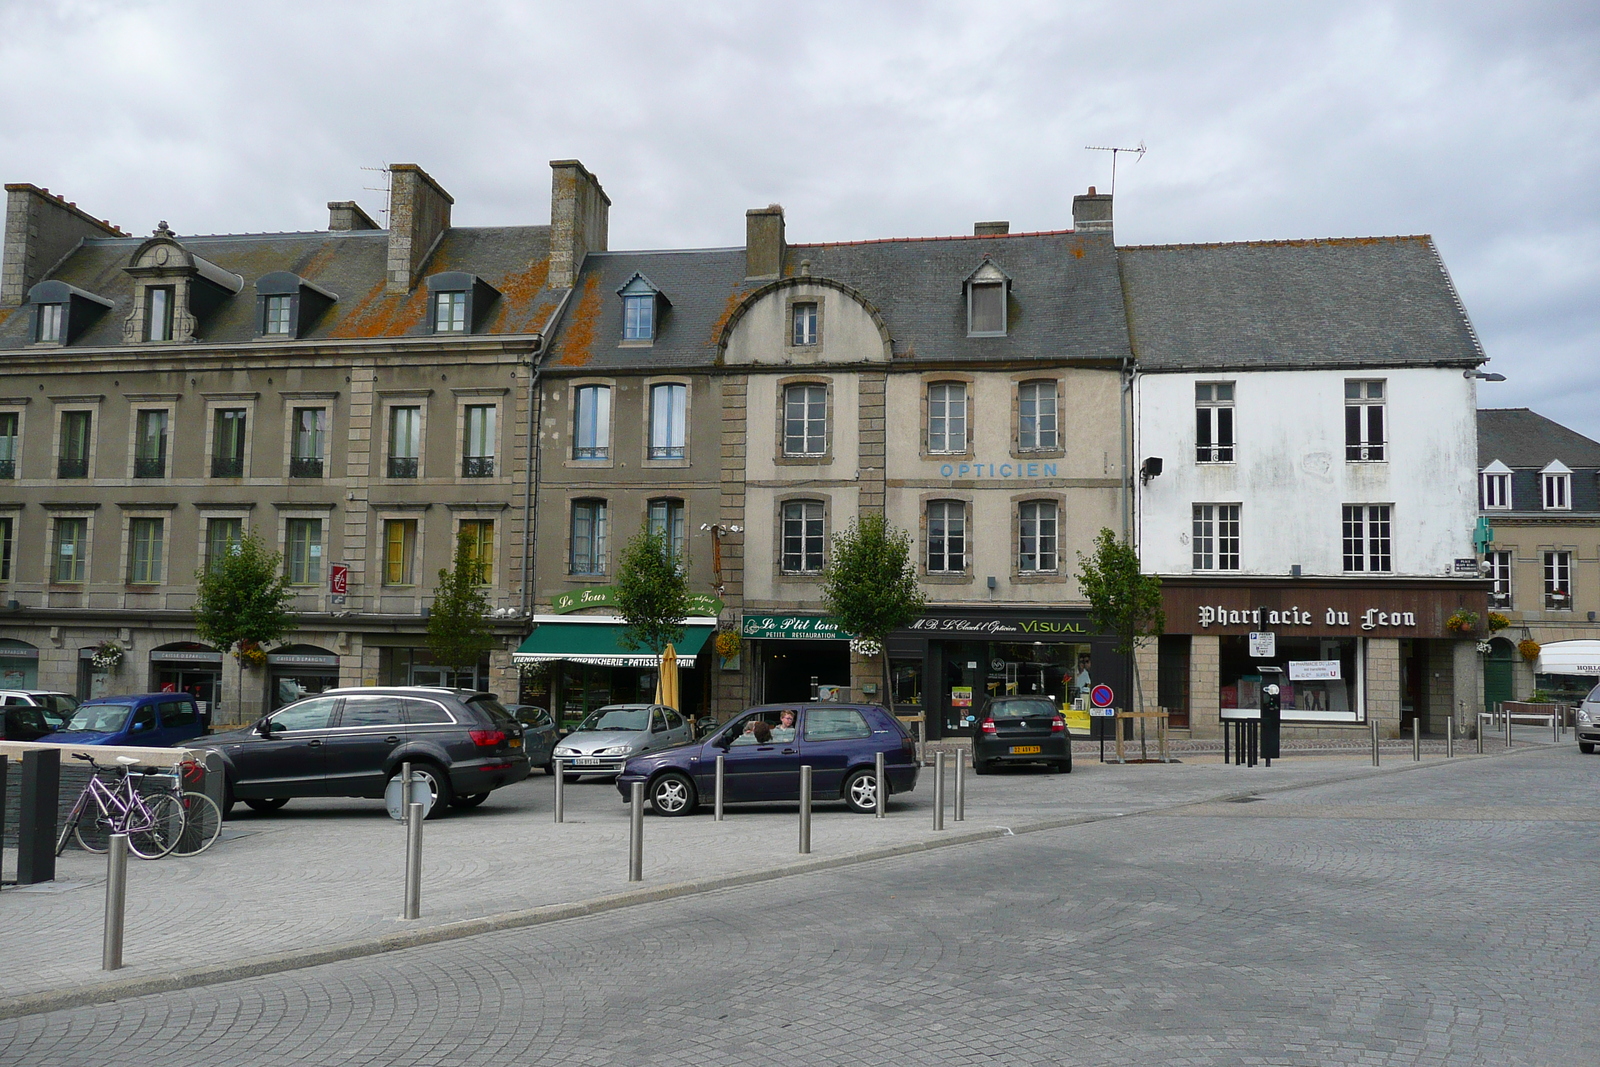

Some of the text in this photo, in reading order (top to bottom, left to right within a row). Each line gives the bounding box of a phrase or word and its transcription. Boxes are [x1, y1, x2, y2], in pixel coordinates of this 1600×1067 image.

[940, 463, 1058, 477] OPTICIEN
[558, 595, 574, 609] Le
[580, 590, 607, 603] Tour
[761, 617, 839, 631] Le P'tit tour
[1325, 607, 1351, 627] du
[1360, 607, 1417, 630] Leon
[1018, 620, 1087, 633] VISUAL
[513, 656, 562, 664] VIENNOIS
[628, 658, 664, 667] PATISSE
[676, 658, 695, 667] PAIN
